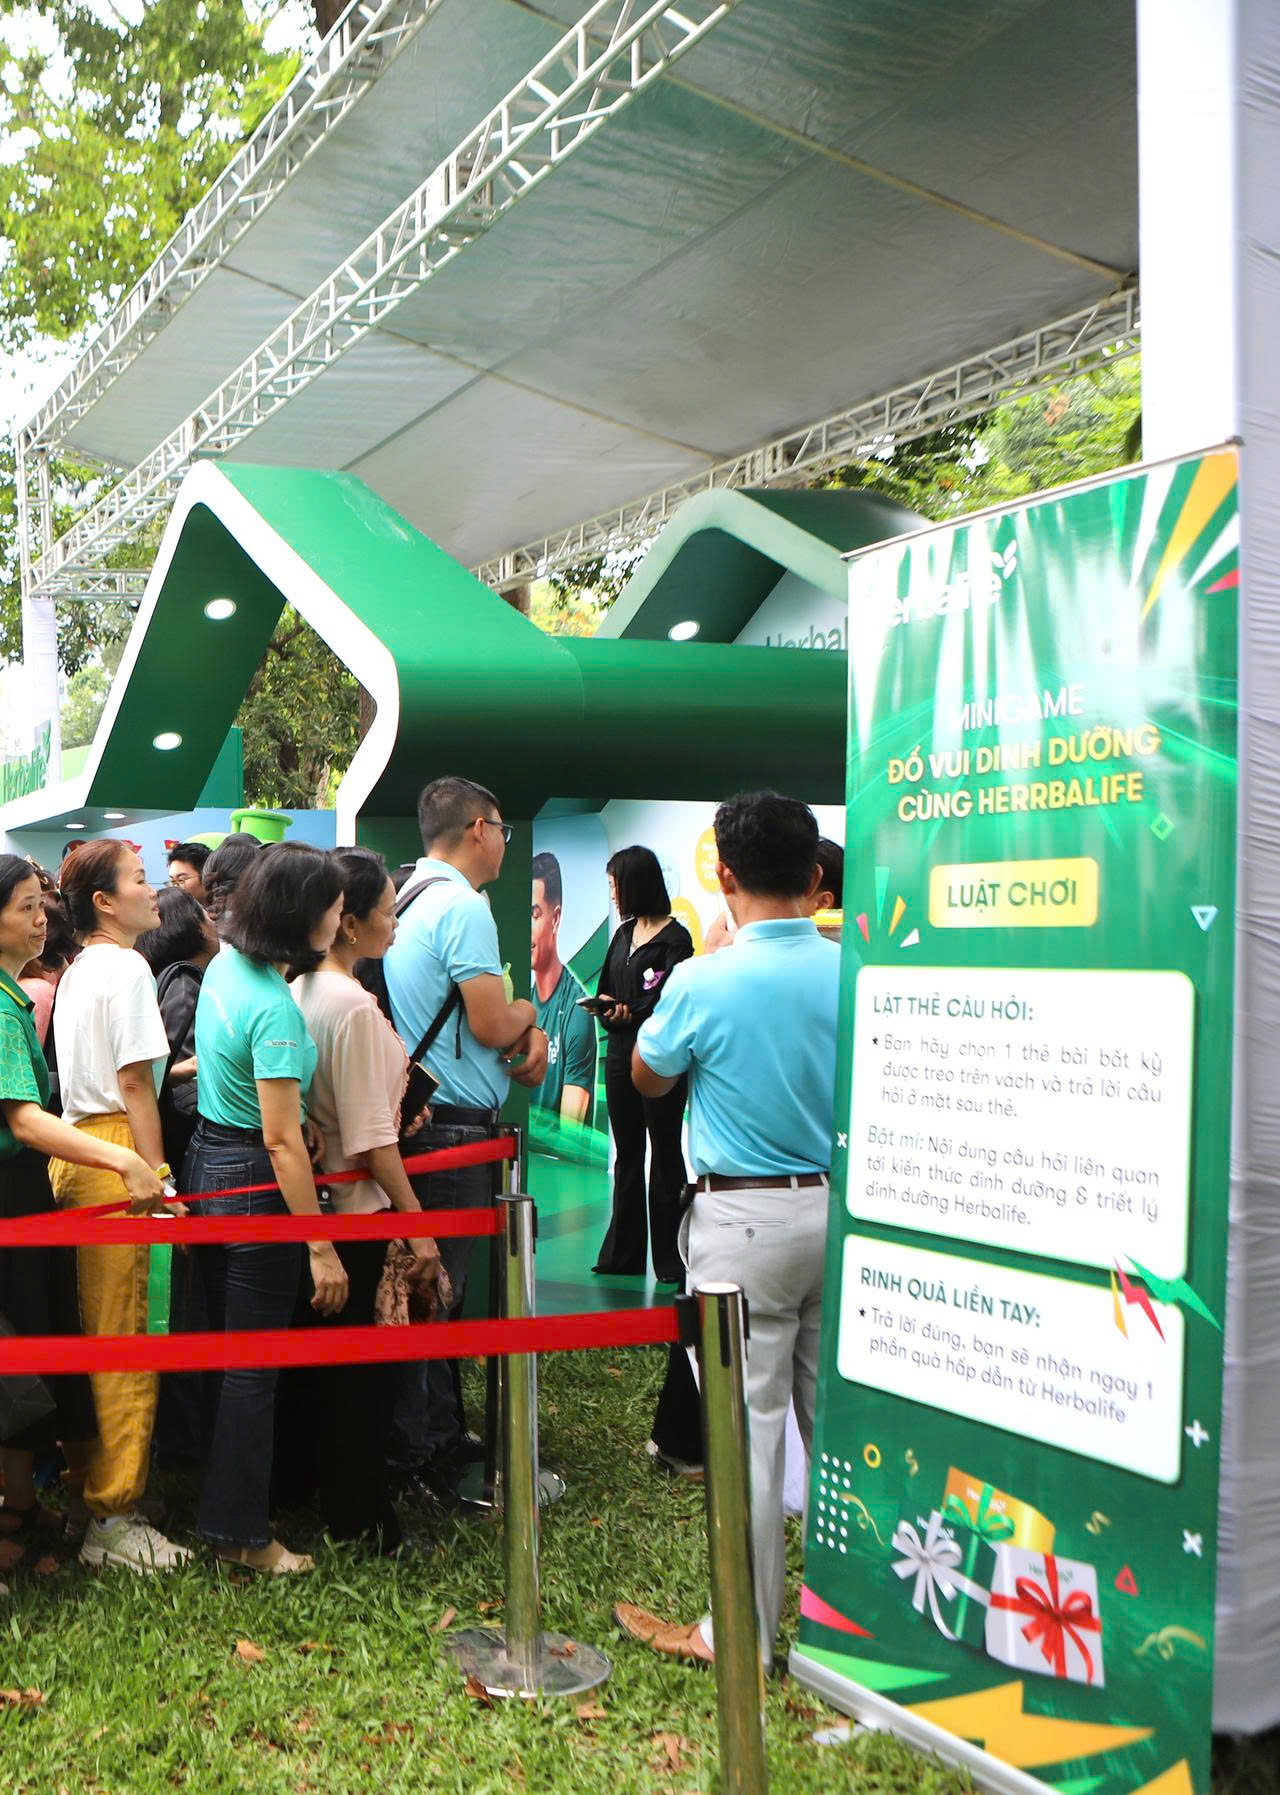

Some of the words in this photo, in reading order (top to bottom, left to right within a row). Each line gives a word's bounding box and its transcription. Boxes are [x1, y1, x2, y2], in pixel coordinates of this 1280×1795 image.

[887, 745, 925, 785] ĐỐ
[928, 749, 970, 779] VUI
[976, 740, 1042, 775] DINH
[1047, 723, 1162, 767] DƯỠNG
[897, 788, 973, 822] CÙNG
[977, 771, 1145, 815] HERRBALIFE
[948, 878, 1001, 913] LUẬT
[1008, 877, 1077, 907] CHƠI
[947, 995, 985, 1018] CÂU
[884, 1033, 912, 1055] Bạn
[958, 1040, 995, 1061] chọn
[1005, 1042, 1012, 1059] 1
[1061, 1045, 1088, 1065] bài
[1100, 1048, 1129, 1069] bất
[1141, 1051, 1163, 1077] kỳ
[921, 1094, 951, 1112] mặt
[956, 1098, 983, 1113] sau
[924, 1065, 955, 1082] treo
[960, 1068, 990, 1085] trên
[995, 1072, 1035, 1090] vách
[1041, 1074, 1062, 1093] và
[1101, 1079, 1121, 1098] lời
[1127, 1082, 1162, 1103] câu
[867, 1125, 894, 1149] Bật
[928, 1136, 953, 1158] Nội
[958, 1139, 998, 1167] dung
[1003, 1148, 1034, 1167] câu
[1074, 1155, 1106, 1177] liên
[1112, 1166, 1160, 1186] quan
[865, 1181, 897, 1201] dinh
[901, 1187, 949, 1215] dưỡng
[954, 1194, 1032, 1225] Herbalife.
[892, 1156, 921, 1177] kiến
[928, 1164, 963, 1185] thức
[970, 1170, 1003, 1191] dinh
[1011, 1177, 1067, 1207] dưỡng
[1096, 1191, 1133, 1214] triết
[1142, 1196, 1159, 1223] lý
[860, 1266, 902, 1293] RINH
[907, 1279, 948, 1305] QUÀ
[953, 1284, 994, 1317] LIỀN
[999, 1299, 1040, 1328] TAY:
[870, 1336, 907, 1360] phần
[911, 1351, 941, 1369] quà
[946, 1355, 976, 1381] hấp
[981, 1365, 1013, 1391] dẫn
[1019, 1377, 1037, 1398] từ
[1041, 1382, 1126, 1424] Herbalife
[899, 1314, 917, 1334] lời
[973, 1334, 1004, 1359] bạn
[1036, 1353, 1082, 1380] nhận
[1090, 1369, 1138, 1401] ngay
[1146, 1381, 1153, 1400] 1
